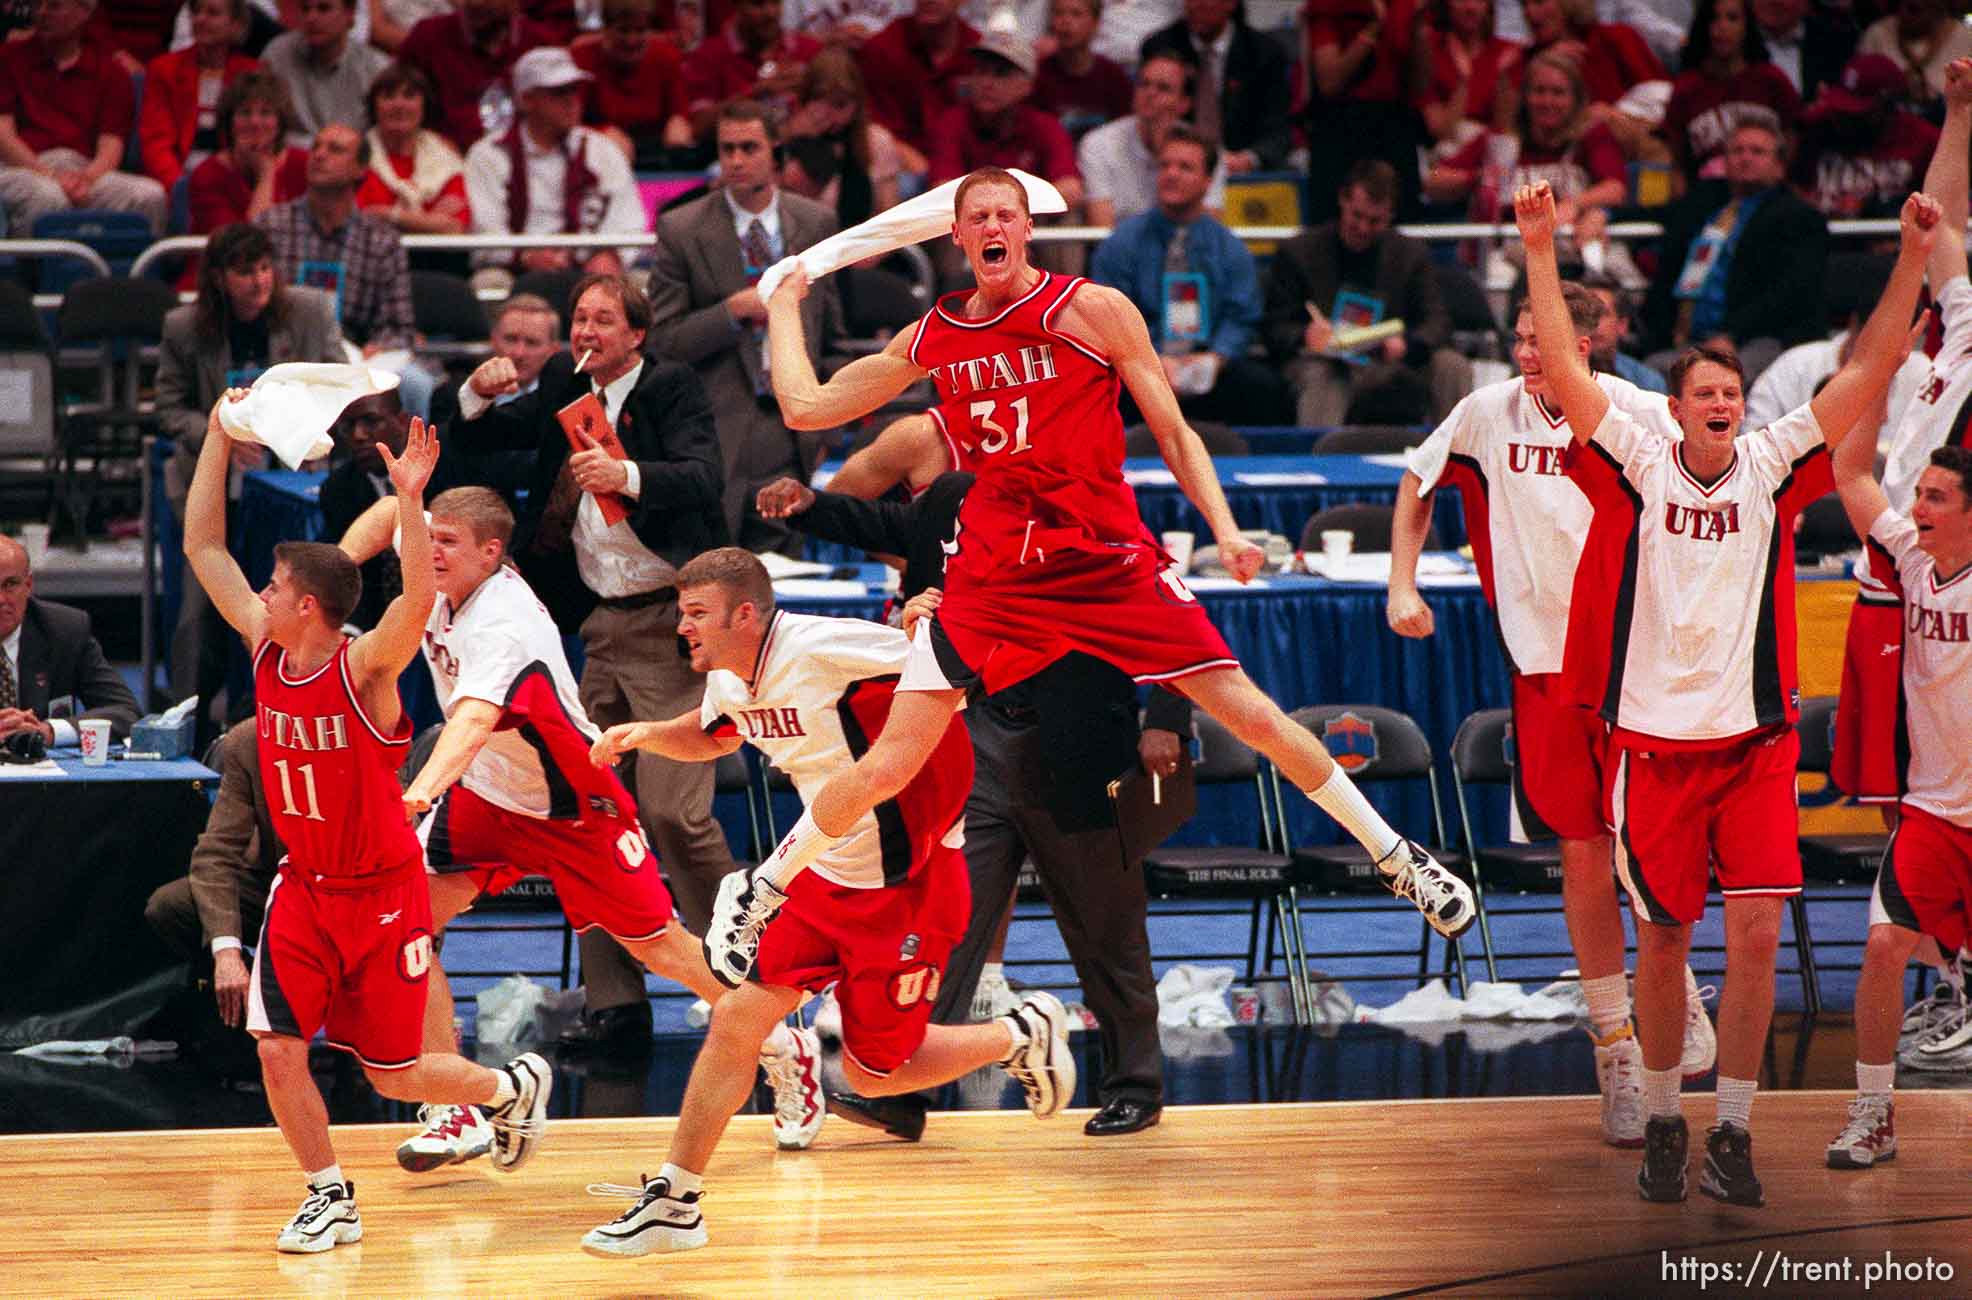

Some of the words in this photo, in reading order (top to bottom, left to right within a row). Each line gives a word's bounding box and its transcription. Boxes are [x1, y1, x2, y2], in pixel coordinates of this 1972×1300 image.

[961, 395, 1033, 455] 31
[1507, 442, 1569, 476] UTA
[1908, 601, 1970, 642] UTAH
[258, 701, 350, 751] UTAH
[737, 707, 807, 738] UTAH
[273, 759, 327, 822] 11
[1185, 869, 1210, 882] THE
[1212, 868, 1248, 881] FINAL
